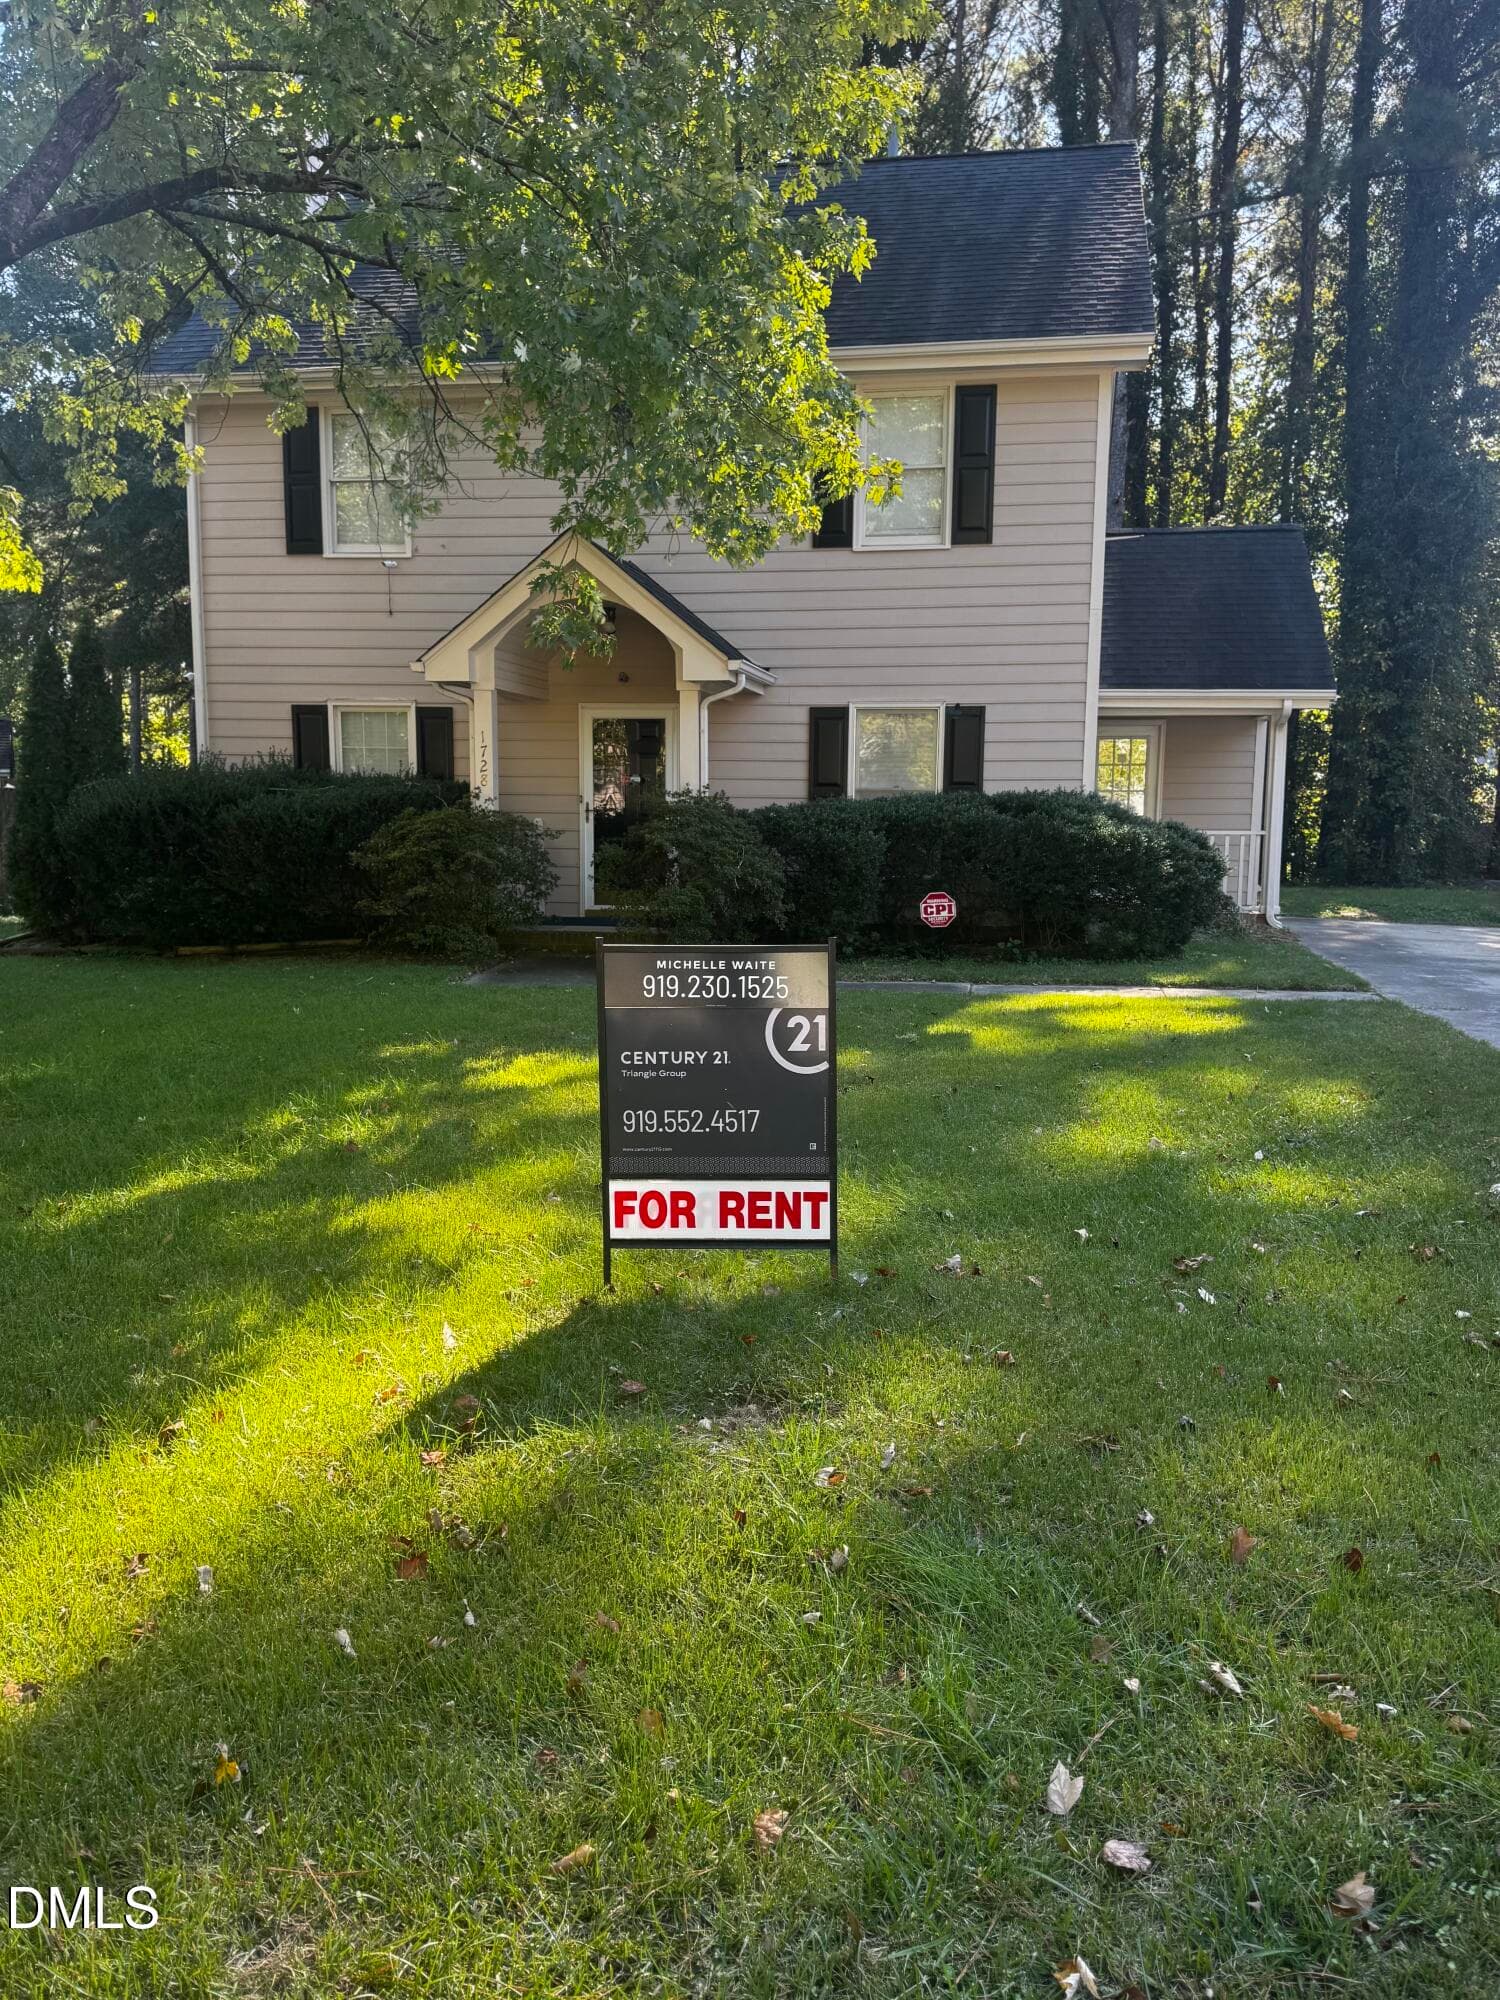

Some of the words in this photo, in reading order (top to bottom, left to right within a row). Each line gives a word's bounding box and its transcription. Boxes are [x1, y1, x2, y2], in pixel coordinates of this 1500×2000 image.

[923, 904, 953, 916] CPI
[656, 960, 726, 970] MICHELLE
[731, 960, 776, 970] WAITE
[643, 975, 789, 998] 919.230.1525
[620, 1051, 708, 1064] CENTURY
[621, 1069, 657, 1079] Triangle
[658, 1069, 687, 1078] Group
[622, 1109, 760, 1132] 919.552.4517
[614, 1190, 696, 1229] FOR
[719, 1191, 828, 1230] RENT
